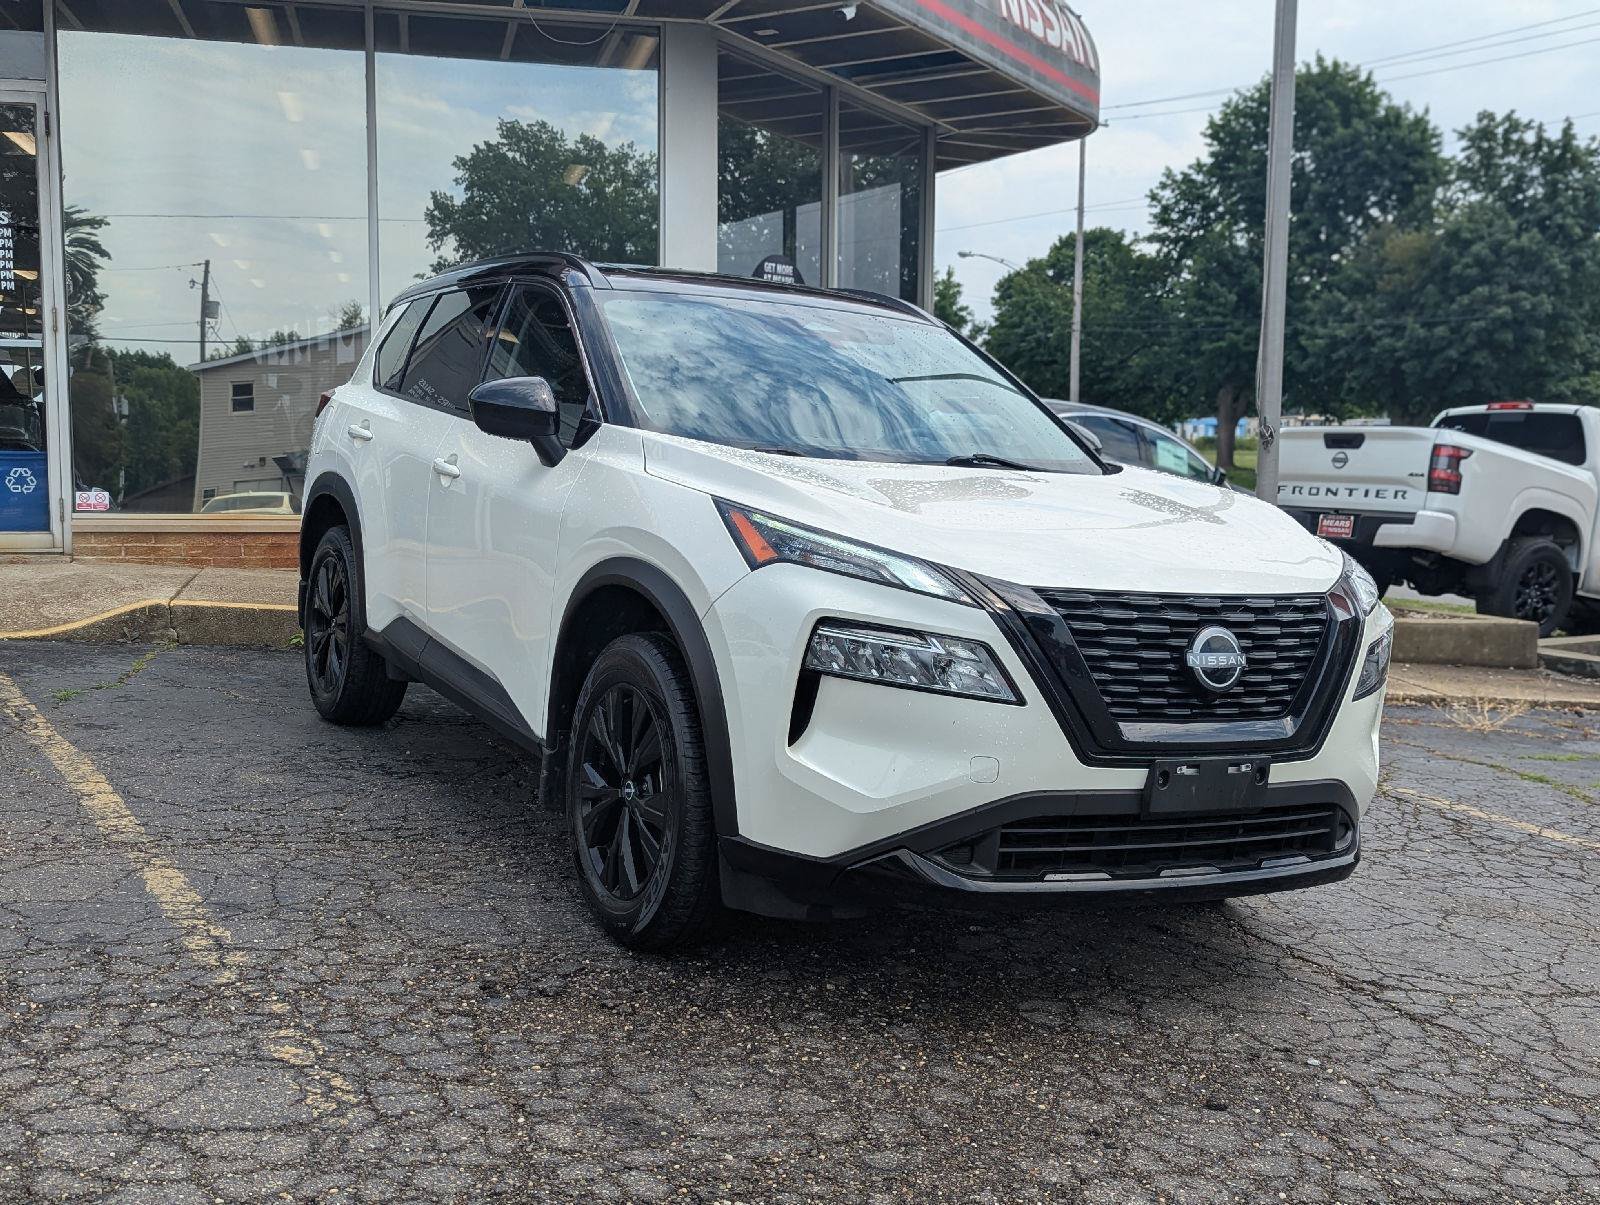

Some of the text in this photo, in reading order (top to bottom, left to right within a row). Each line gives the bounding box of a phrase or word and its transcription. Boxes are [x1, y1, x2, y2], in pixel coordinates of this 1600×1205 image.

[0, 250, 13, 259] PM
[0, 261, 14, 269] PM
[764, 262, 794, 276] GET MORE
[0, 271, 14, 280] PM
[1, 281, 15, 290] PM
[1277, 485, 1408, 500] FRONTIER
[1322, 519, 1351, 528] MEARS
[1189, 655, 1246, 665] NISSAN
